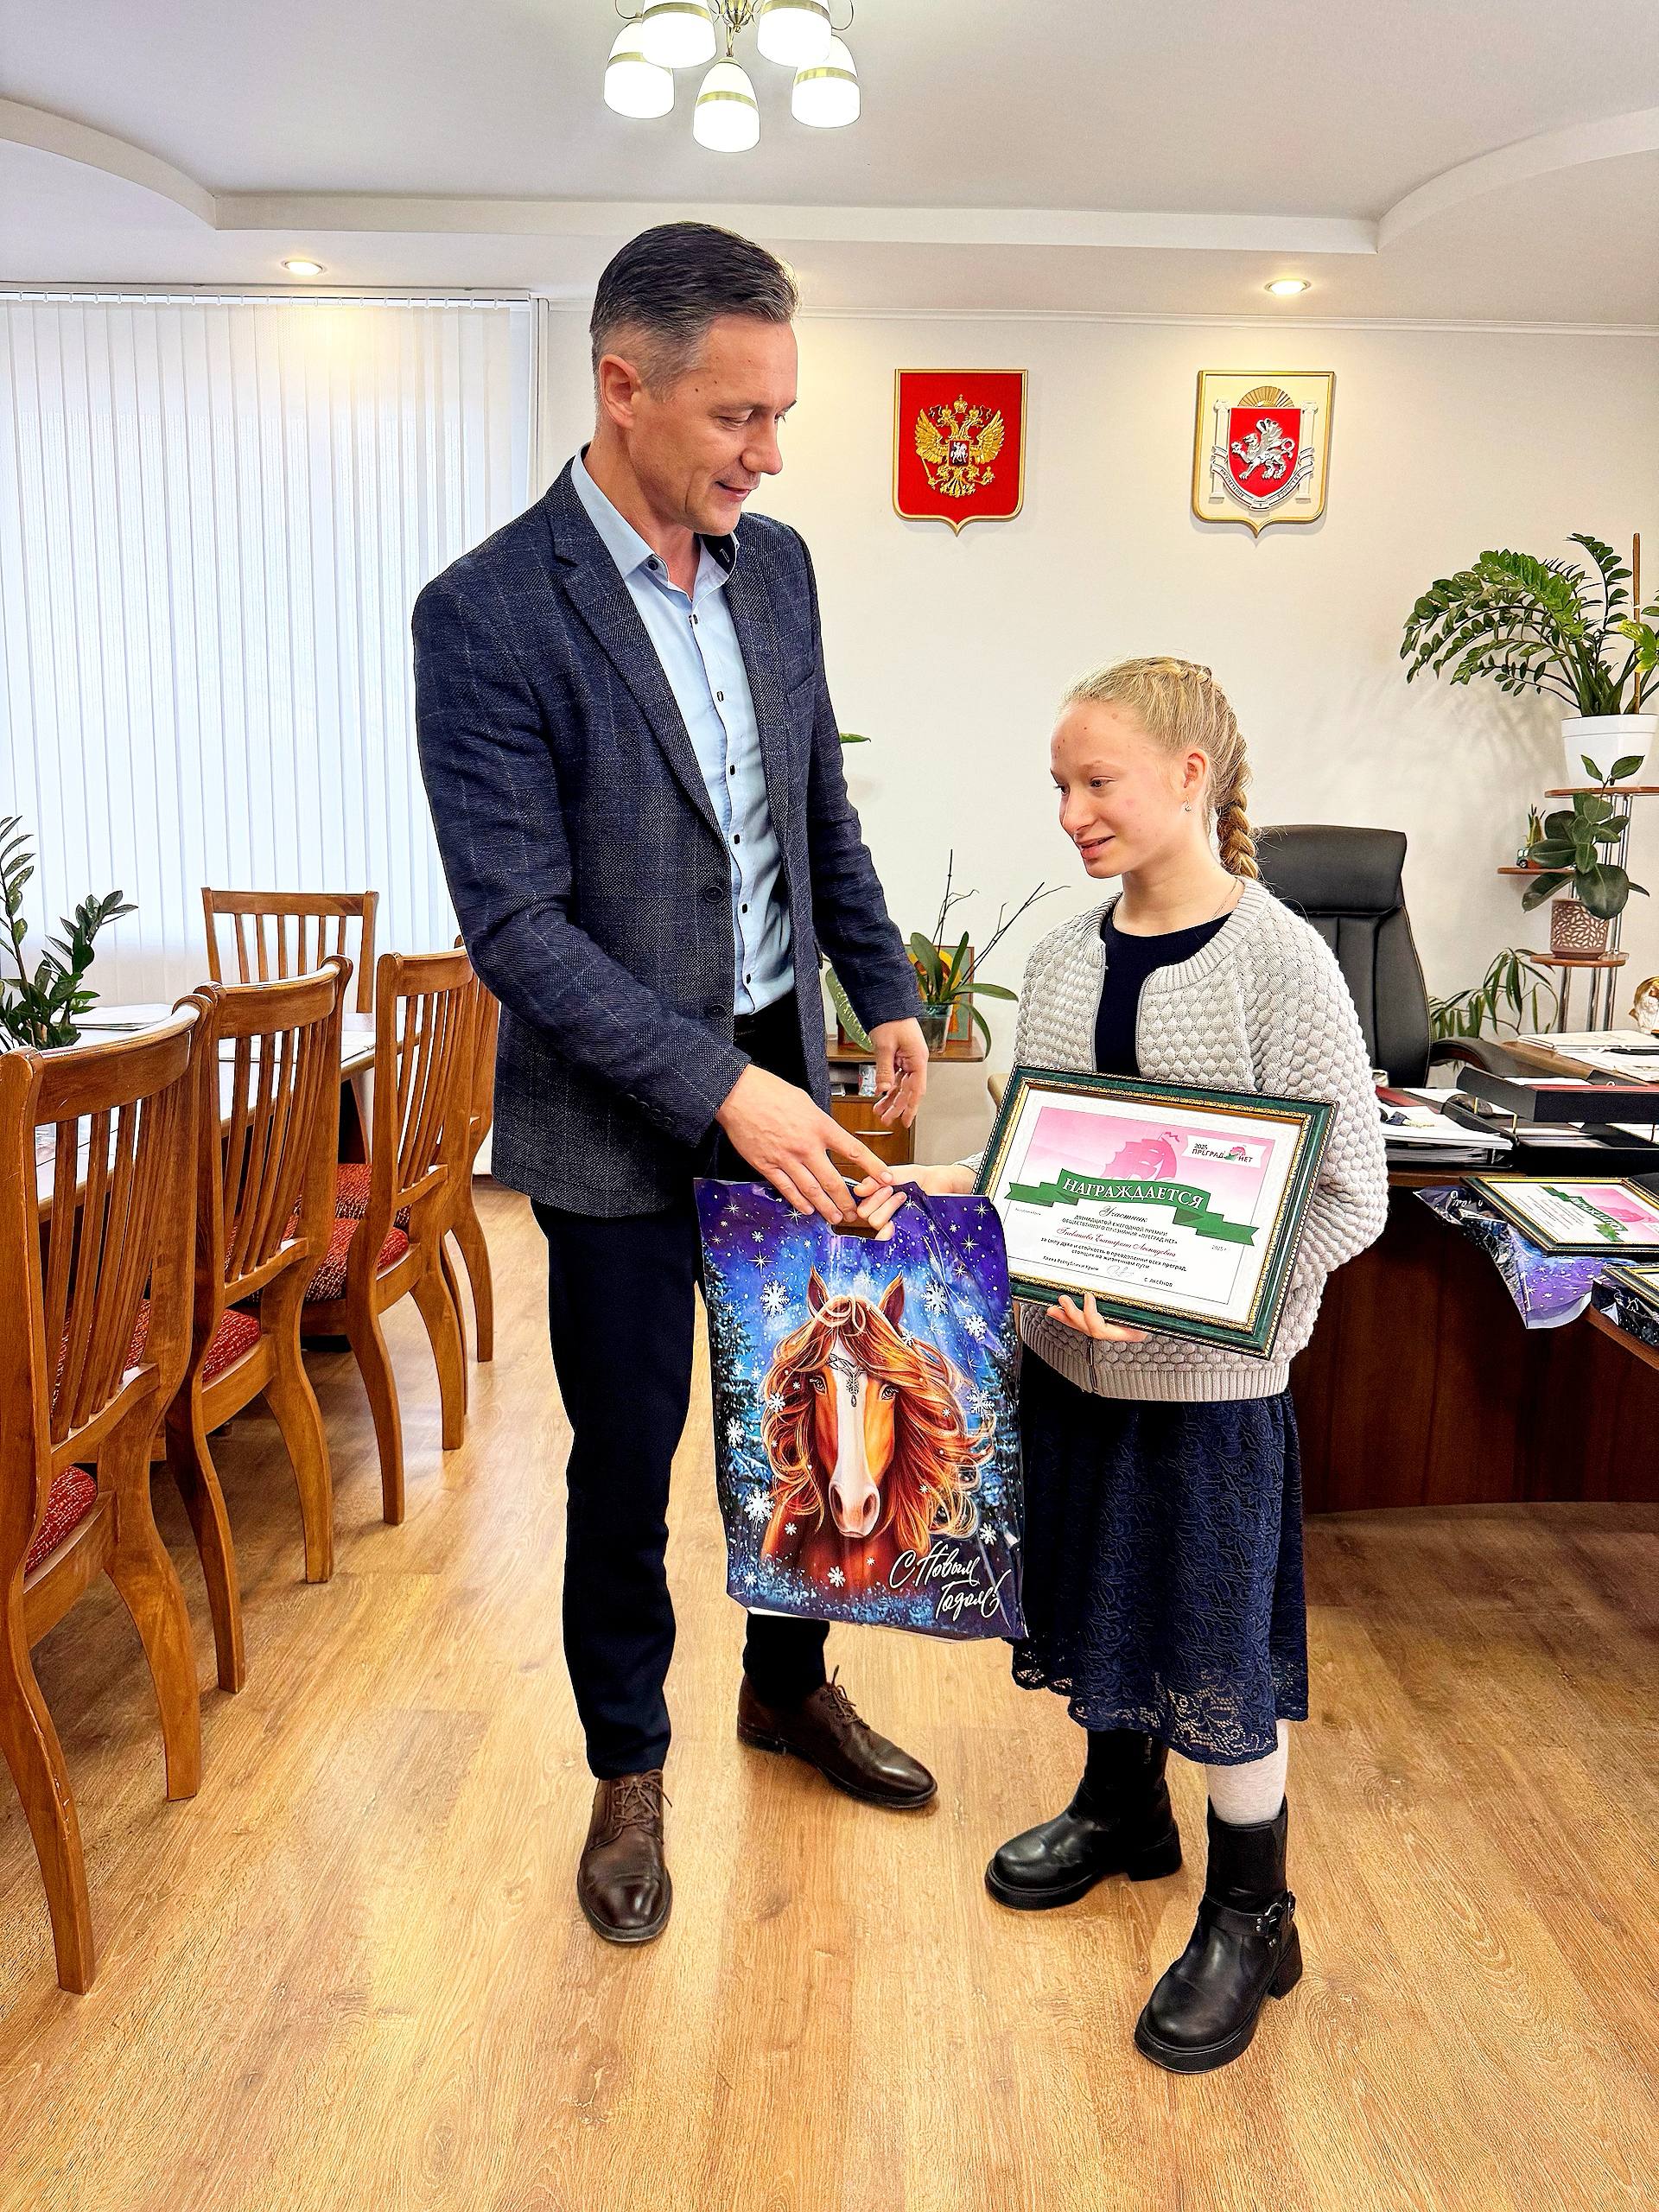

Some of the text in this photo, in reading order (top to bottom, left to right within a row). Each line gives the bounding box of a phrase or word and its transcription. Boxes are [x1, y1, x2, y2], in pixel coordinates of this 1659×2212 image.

[1192, 1148, 1224, 1159] ПРЕГРАД
[1063, 1177, 1205, 1210] НАГРАЖДАЕТСЯ
[1098, 1205, 1148, 1223] Участник
[1062, 1218, 1105, 1230] ОБЩЕСТВЕННОГО
[1105, 1226, 1138, 1236] ПРИЗНАНИЯ
[1073, 1215, 1168, 1236] ДВЕНАДЦАТОЙ ЕЖЕГОДНОЙ ПРЕМИИ
[1095, 1233, 1132, 1248] Екатерина
[1077, 1245, 1106, 1255] стойкость
[1110, 1251, 1148, 1263] преодолении
[1103, 1256, 1135, 1266] жизненном
[889, 1540, 980, 1589] С Новым
